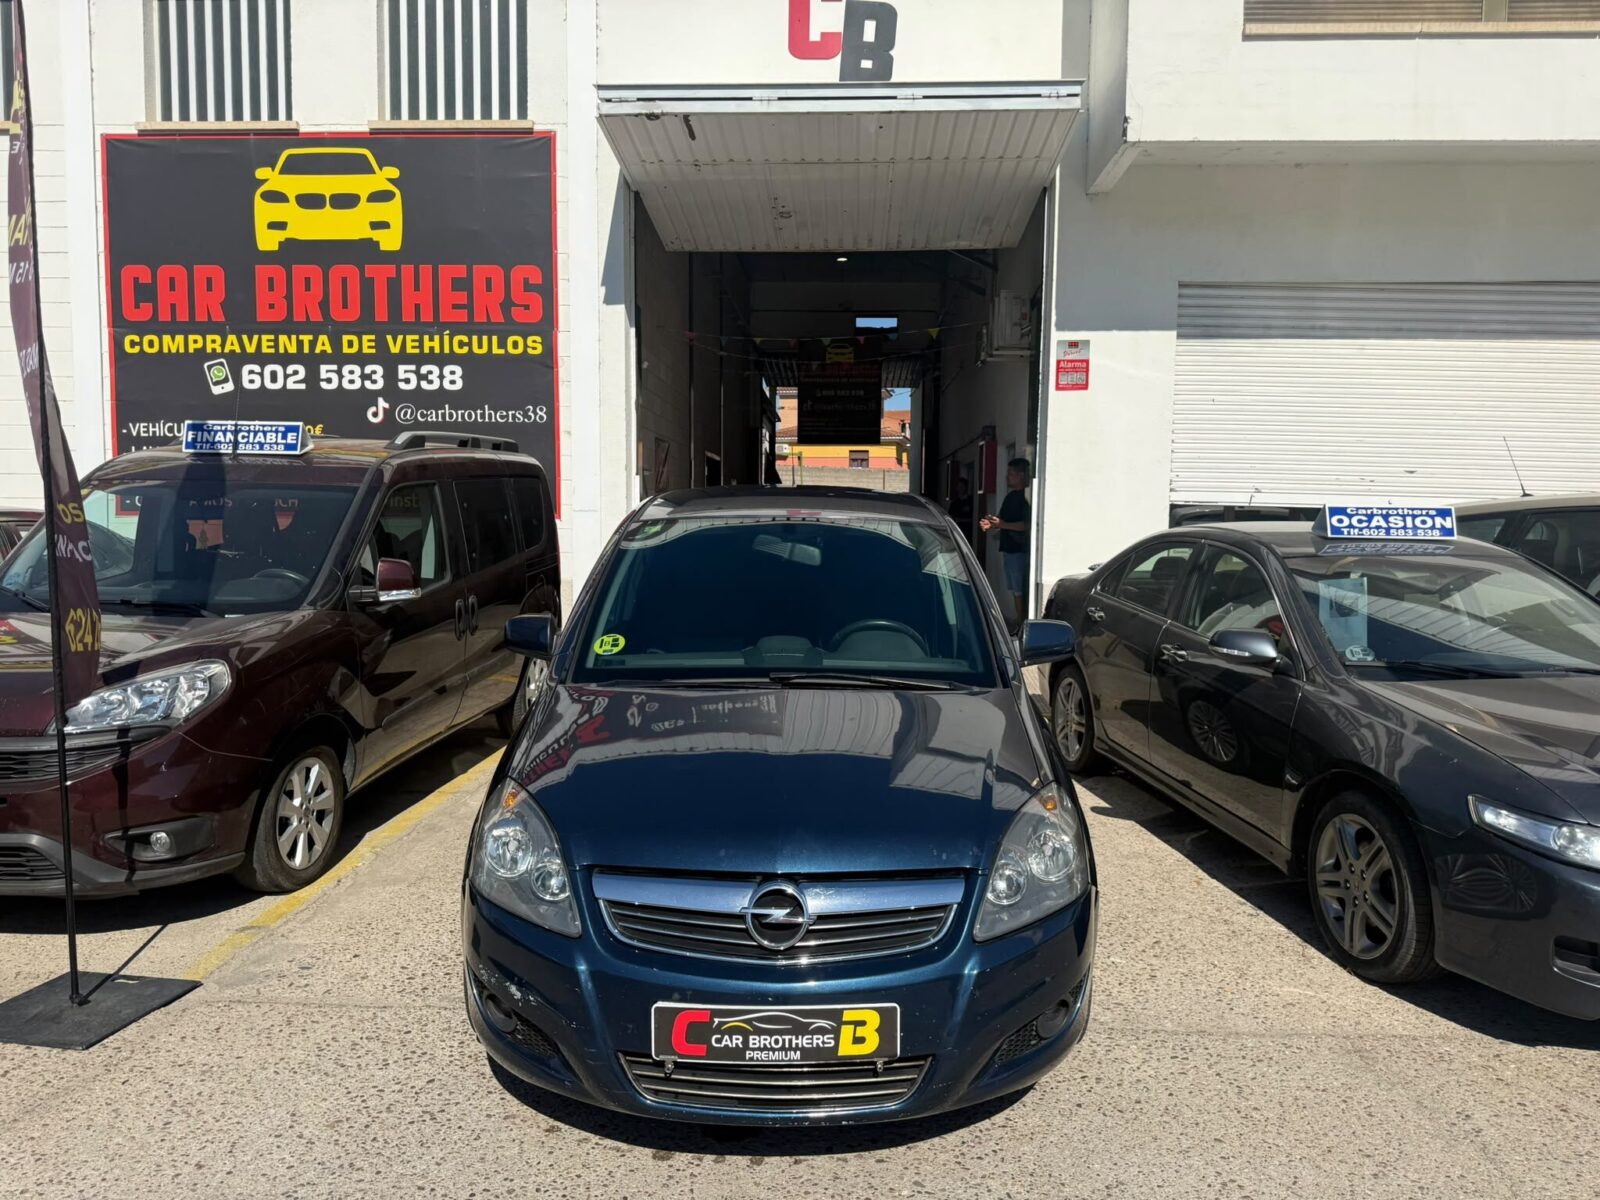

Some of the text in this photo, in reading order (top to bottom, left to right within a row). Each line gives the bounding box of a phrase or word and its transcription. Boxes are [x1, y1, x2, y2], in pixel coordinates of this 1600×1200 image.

[120, 264, 543, 323] CAR BROTHERS
[124, 330, 543, 355] COMPRAVENTA DE VEHÍCULOS
[1059, 360, 1087, 369] Alarma
[241, 364, 463, 390] 602 583 538
[395, 403, 547, 424] @carbrothers38
[203, 424, 285, 432] Carbrothers
[187, 431, 297, 443] FINANCIABLE
[238, 443, 260, 451] 583
[1346, 507, 1437, 515] Carbrothers
[1330, 515, 1453, 529] OCASION
[1341, 528, 1440, 537] Tlf-602 583 538
[671, 1009, 881, 1057] C CAR BROTHERS B
[745, 1050, 801, 1061] PREMIUM
